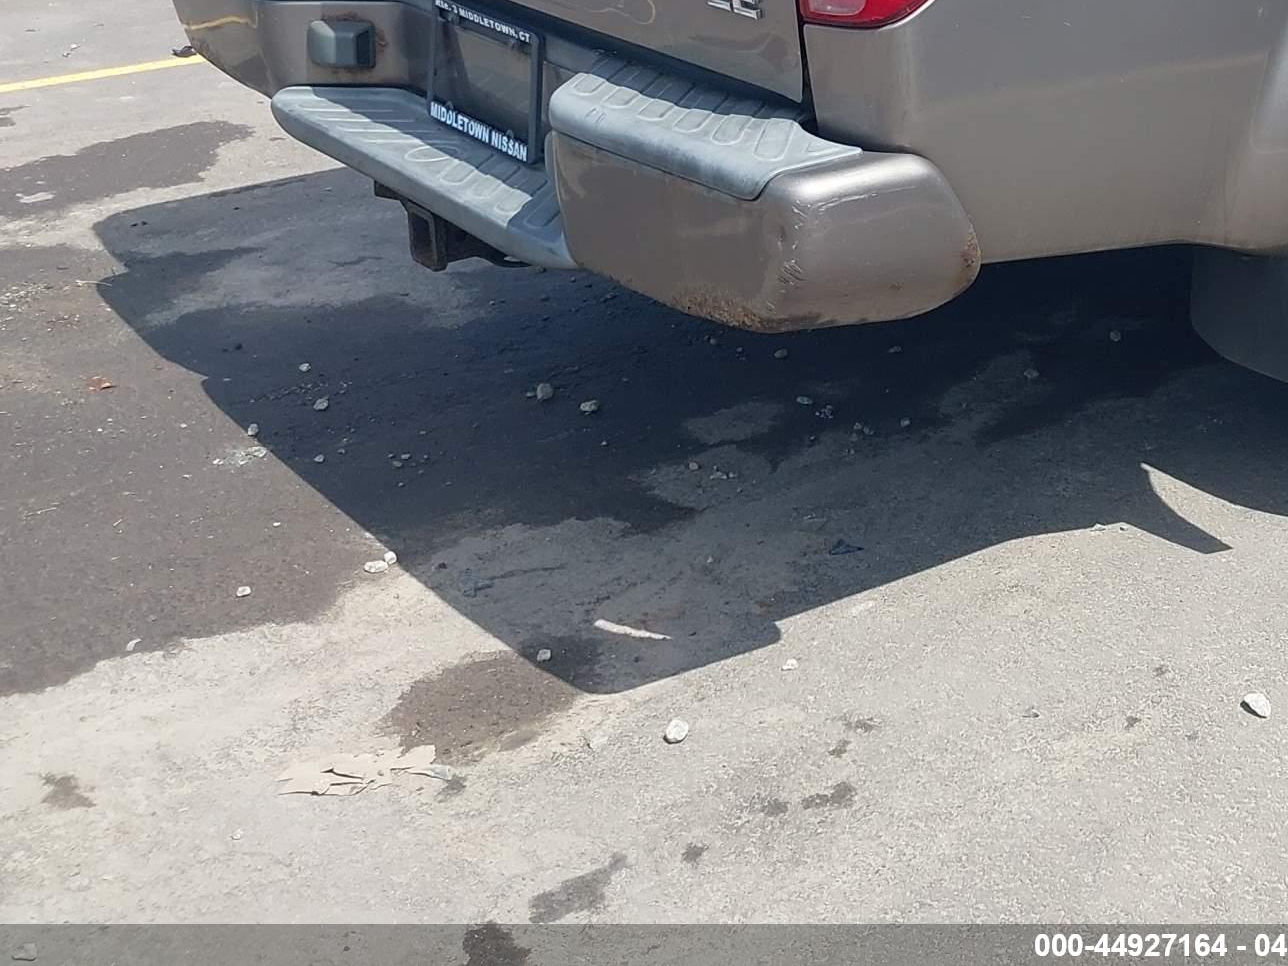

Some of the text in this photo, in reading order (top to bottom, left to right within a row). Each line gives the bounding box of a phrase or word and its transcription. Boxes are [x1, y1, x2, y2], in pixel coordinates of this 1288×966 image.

[459, 7, 519, 40] MIDDLETOWN,
[518, 31, 531, 43] CT
[430, 101, 529, 163] MIDDLETOWN NISSAN
